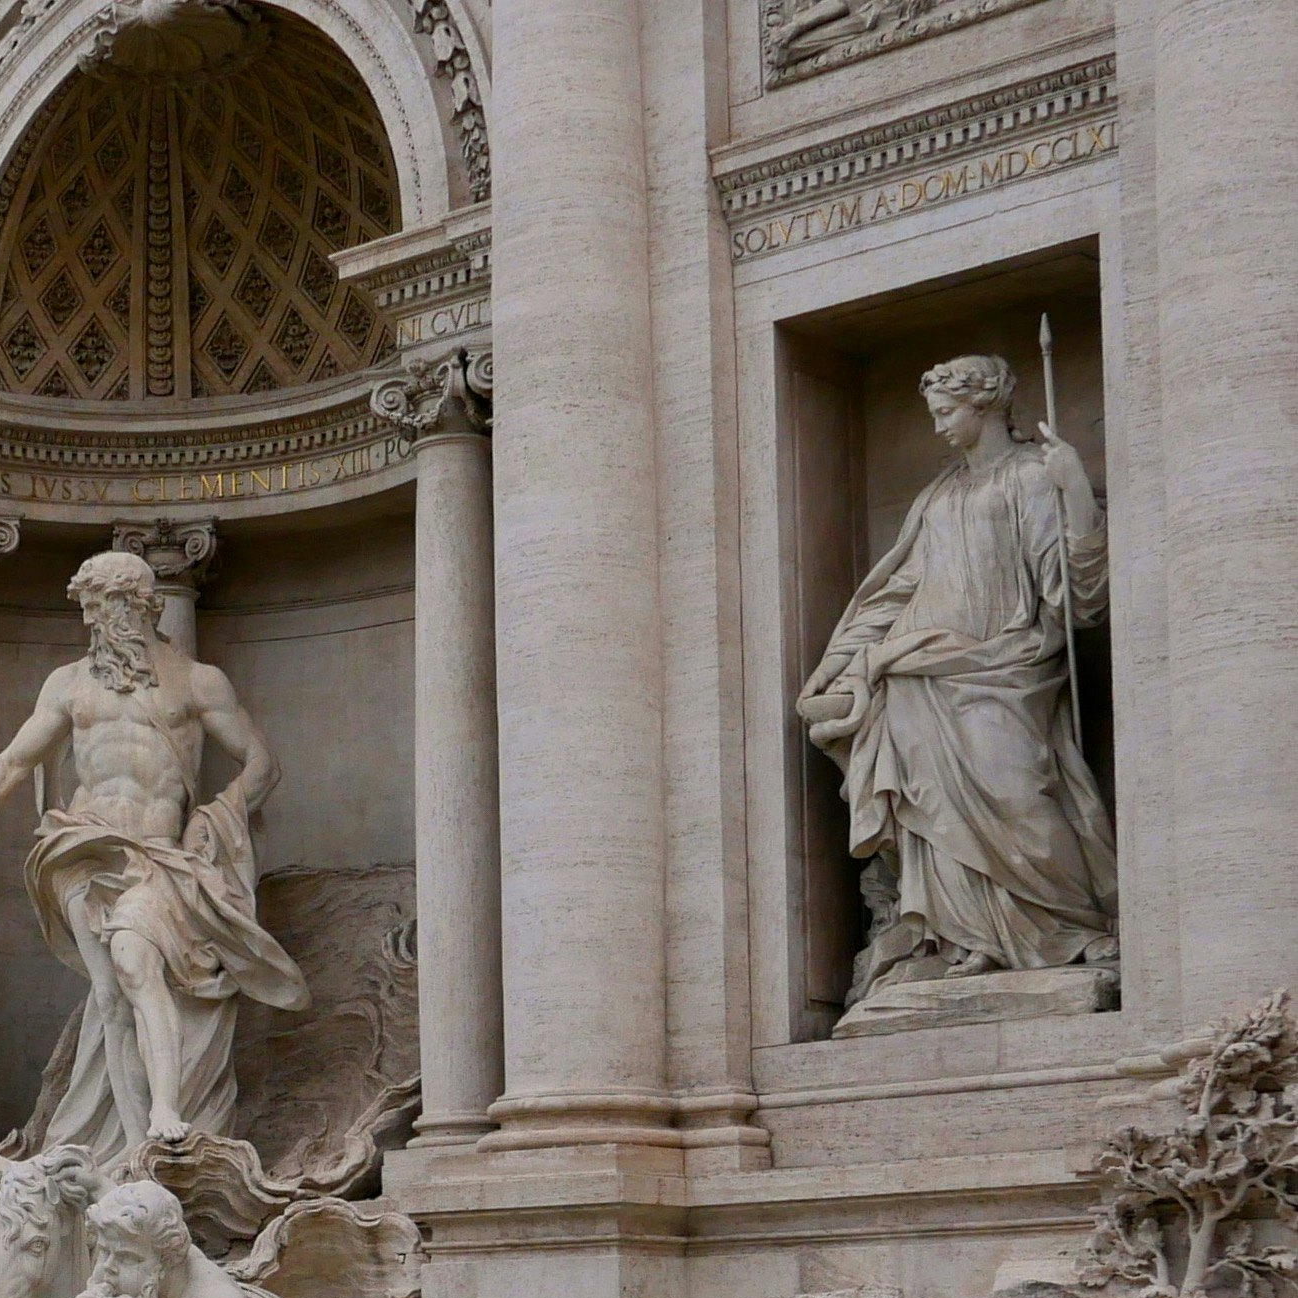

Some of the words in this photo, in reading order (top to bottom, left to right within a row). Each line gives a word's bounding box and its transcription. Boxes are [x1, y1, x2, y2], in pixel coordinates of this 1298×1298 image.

[733, 198, 861, 258] SOLVTVM
[29, 474, 111, 500] IVSSV
[131, 458, 321, 502] CLEMENTIS
